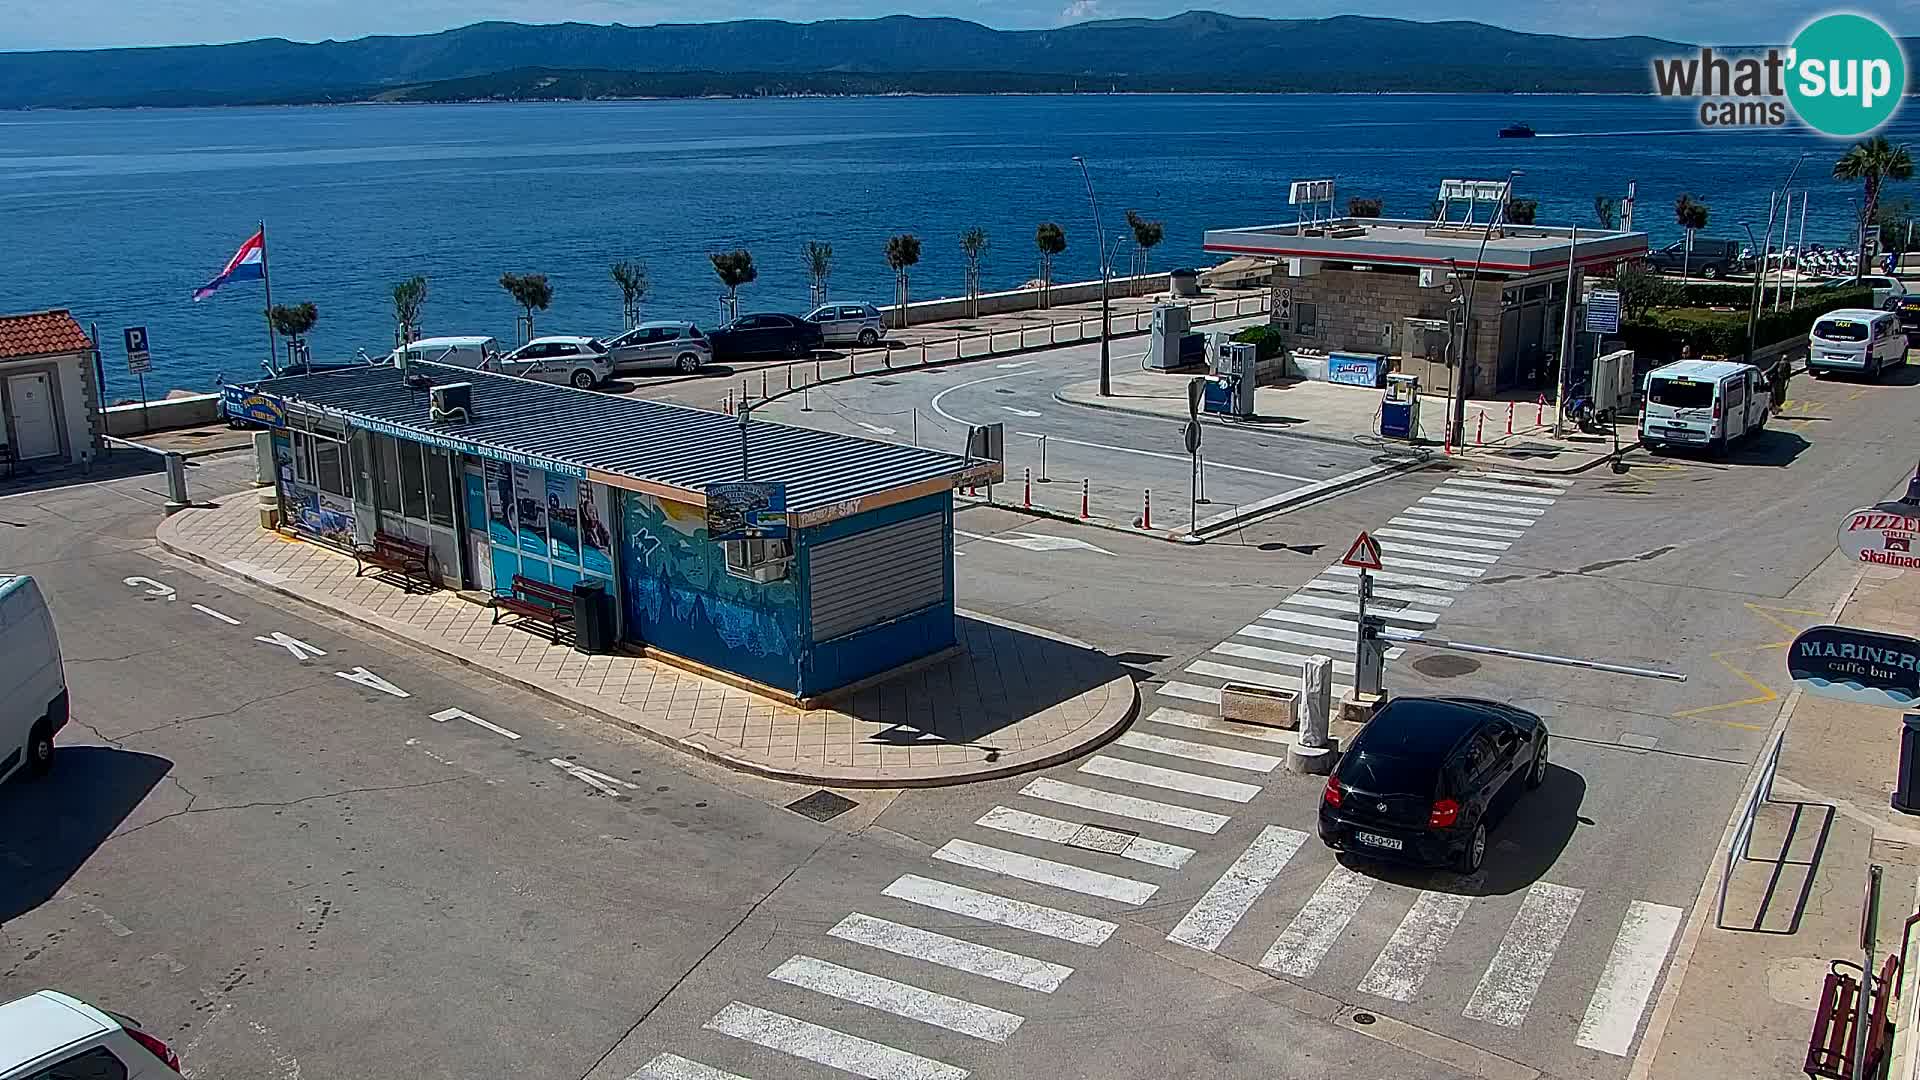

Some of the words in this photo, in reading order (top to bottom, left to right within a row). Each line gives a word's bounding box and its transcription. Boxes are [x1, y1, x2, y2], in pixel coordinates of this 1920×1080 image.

[1835, 320, 1852, 328] TAXI
[130, 331, 142, 349] P
[395, 426, 436, 445] AUTOBUSNA
[436, 438, 468, 452] POSTAJA
[478, 447, 493, 457] BUS
[494, 450, 526, 465] STATION
[527, 457, 554, 470] TICKET
[555, 463, 582, 477] OFFICE
[1847, 514, 1920, 534] PIZZE
[1882, 530, 1917, 541] GRILL
[1828, 661, 1866, 676] caffe
[1870, 664, 1897, 680] bar
